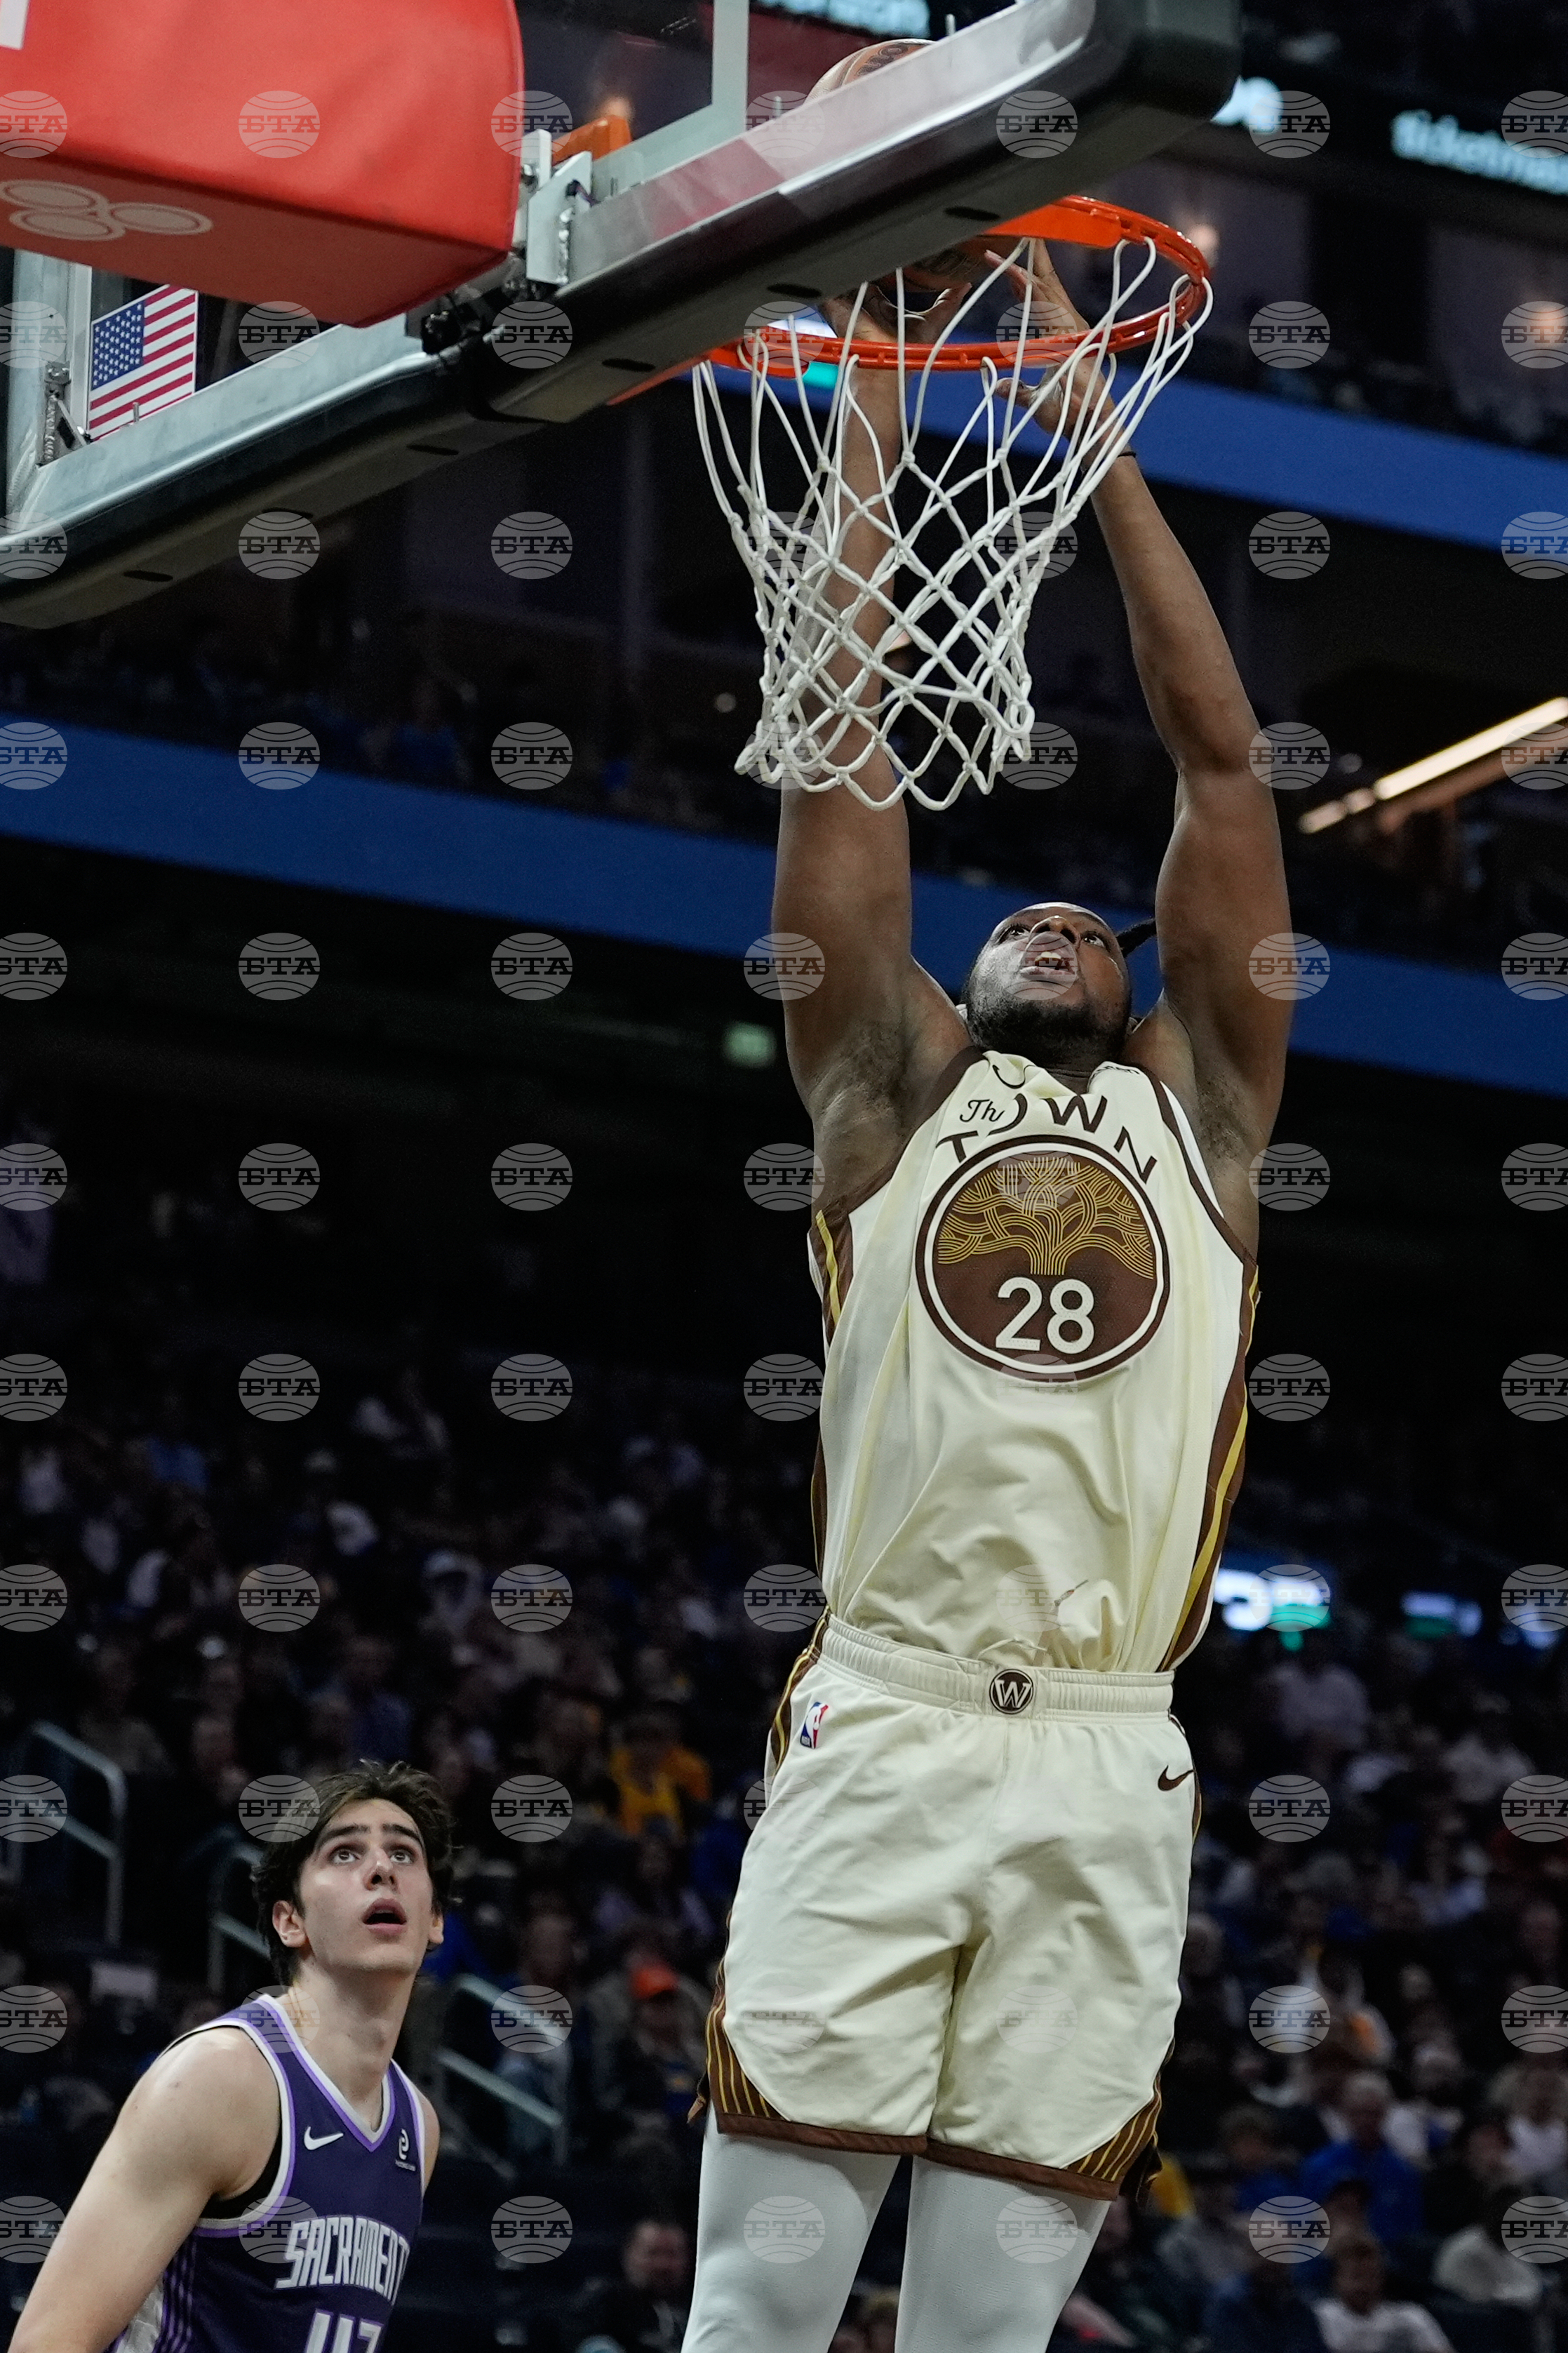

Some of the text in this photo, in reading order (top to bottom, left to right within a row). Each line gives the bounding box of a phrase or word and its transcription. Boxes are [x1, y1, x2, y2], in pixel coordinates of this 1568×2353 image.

[959, 1098, 1005, 1123] Th
[996, 1277, 1095, 1354] 28
[994, 1679, 1032, 1708] W
[274, 2215, 410, 2306] SACRAMENT
